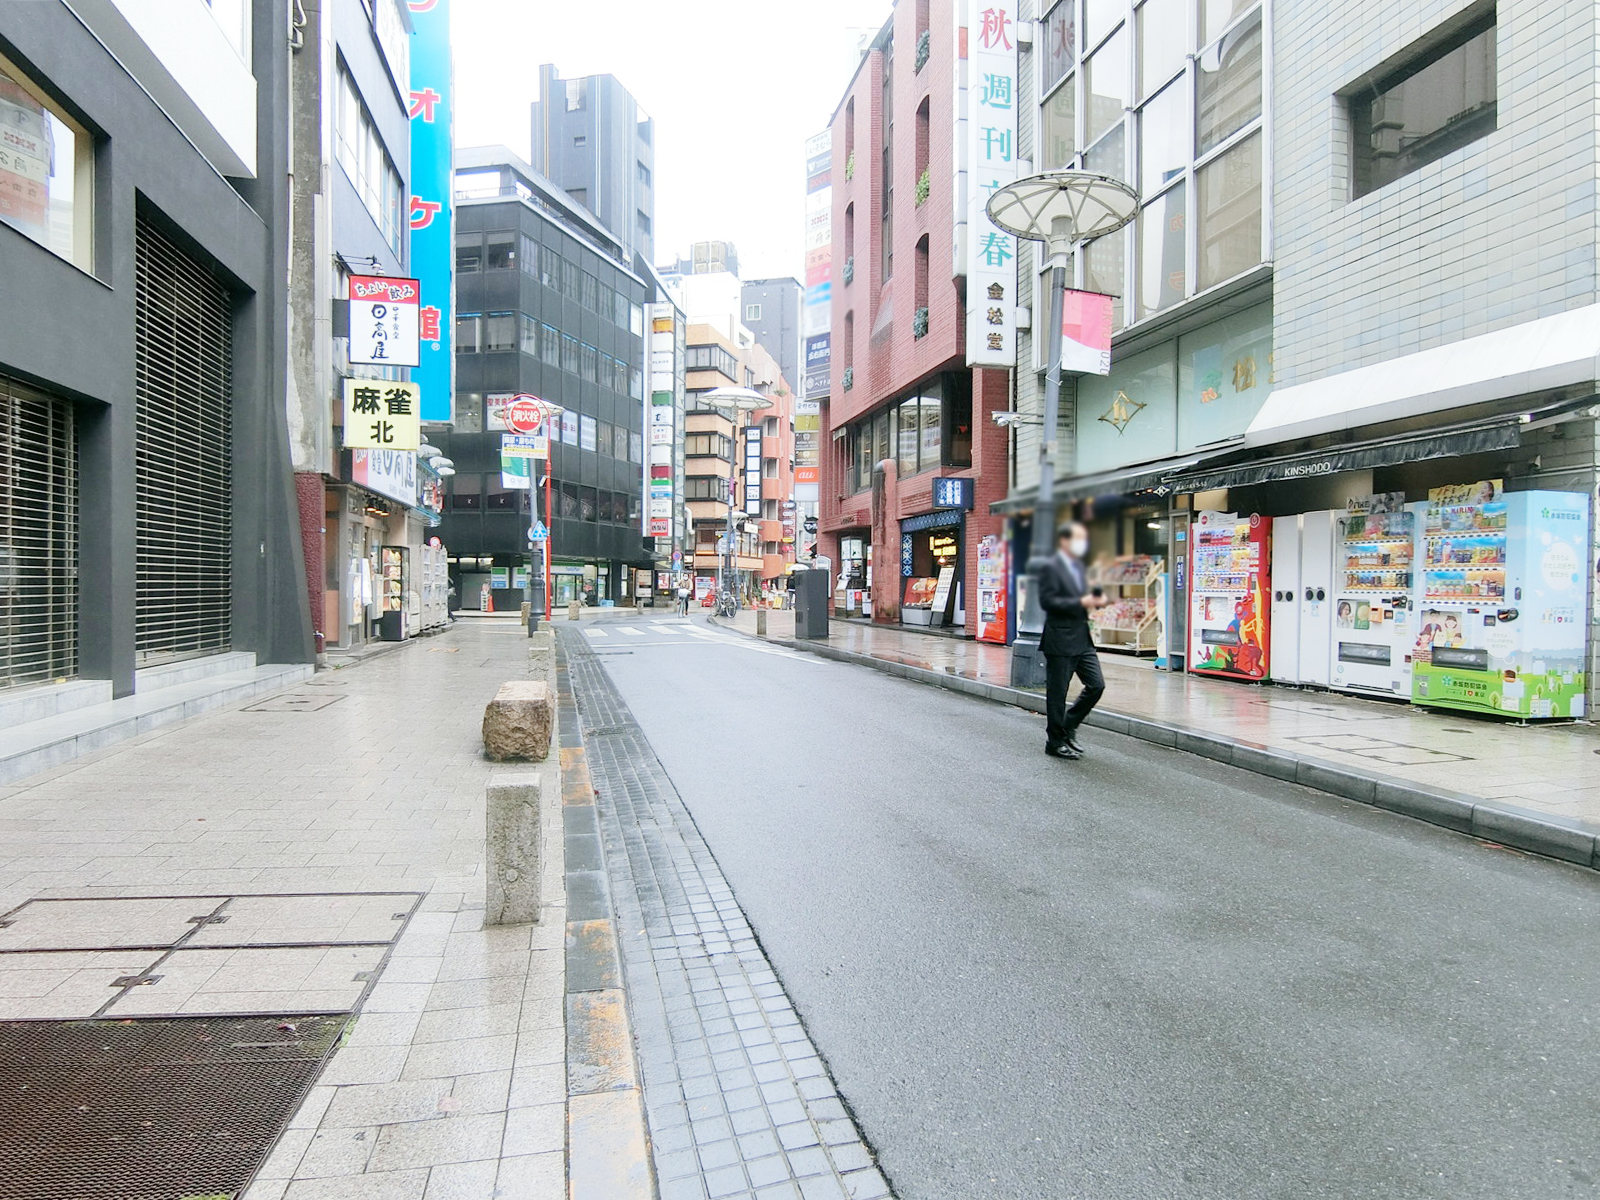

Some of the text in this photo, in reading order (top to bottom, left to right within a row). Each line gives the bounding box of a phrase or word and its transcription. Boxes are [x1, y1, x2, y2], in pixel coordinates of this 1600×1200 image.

[356, 281, 415, 300] ちょい飲み
[987, 282, 1004, 351] 金松堂
[370, 304, 389, 359] 日高屋
[352, 387, 412, 415] 麻雀
[513, 410, 539, 422] 消火栓
[370, 421, 393, 443] 北
[798, 471, 815, 479] au
[1284, 461, 1330, 477] KINSHODO
[1451, 506, 1474, 514] KIRIN
